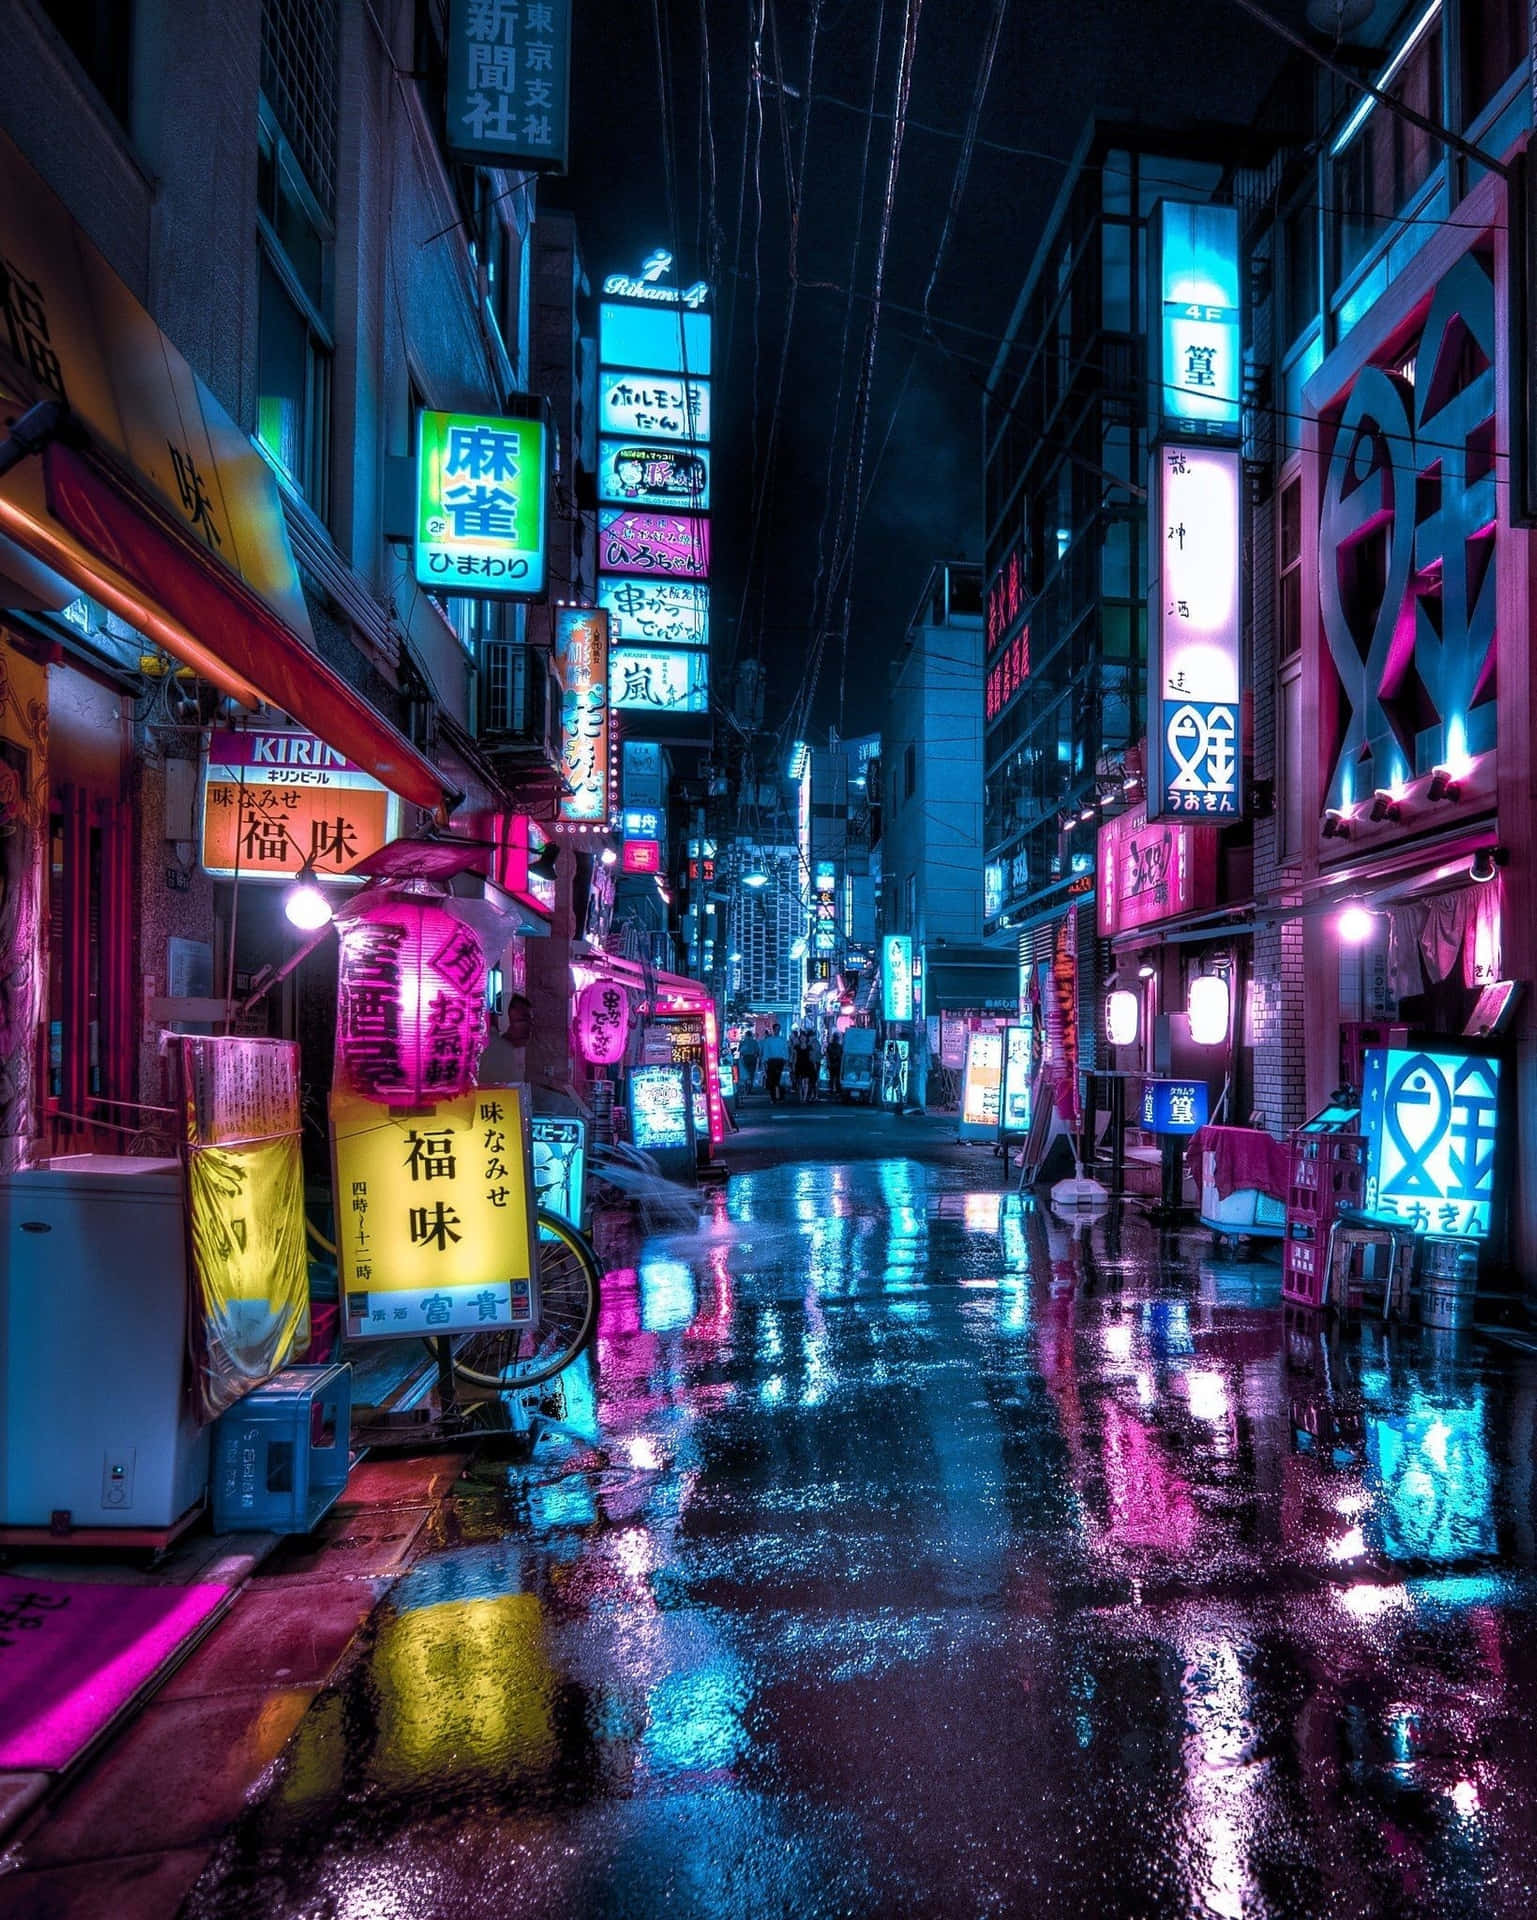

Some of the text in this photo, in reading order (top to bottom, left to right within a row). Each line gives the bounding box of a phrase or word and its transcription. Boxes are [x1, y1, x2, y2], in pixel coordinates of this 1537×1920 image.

[461, 0, 519, 141] 新聞社
[521, 2, 554, 145] 東京支社
[1184, 304, 1223, 321] 4F
[635, 412, 680, 431] だん
[165, 438, 222, 548] 味
[442, 424, 521, 542] 麻雀
[429, 521, 446, 534] 2F
[428, 551, 529, 580] ひまわり
[606, 541, 703, 573] ひろちゃん
[614, 582, 681, 618] 串かつ
[636, 617, 701, 641] でんがな
[617, 662, 664, 706] 嵐
[252, 736, 347, 767] KIRIN
[267, 769, 330, 786] キリンビール
[212, 789, 302, 810] 味なみせ
[1167, 791, 1235, 812] うおきん
[241, 811, 359, 865] 福味
[479, 1101, 510, 1209] 味なみせ
[403, 1127, 463, 1253] 福味
[420, 1289, 509, 1326] 富貴
